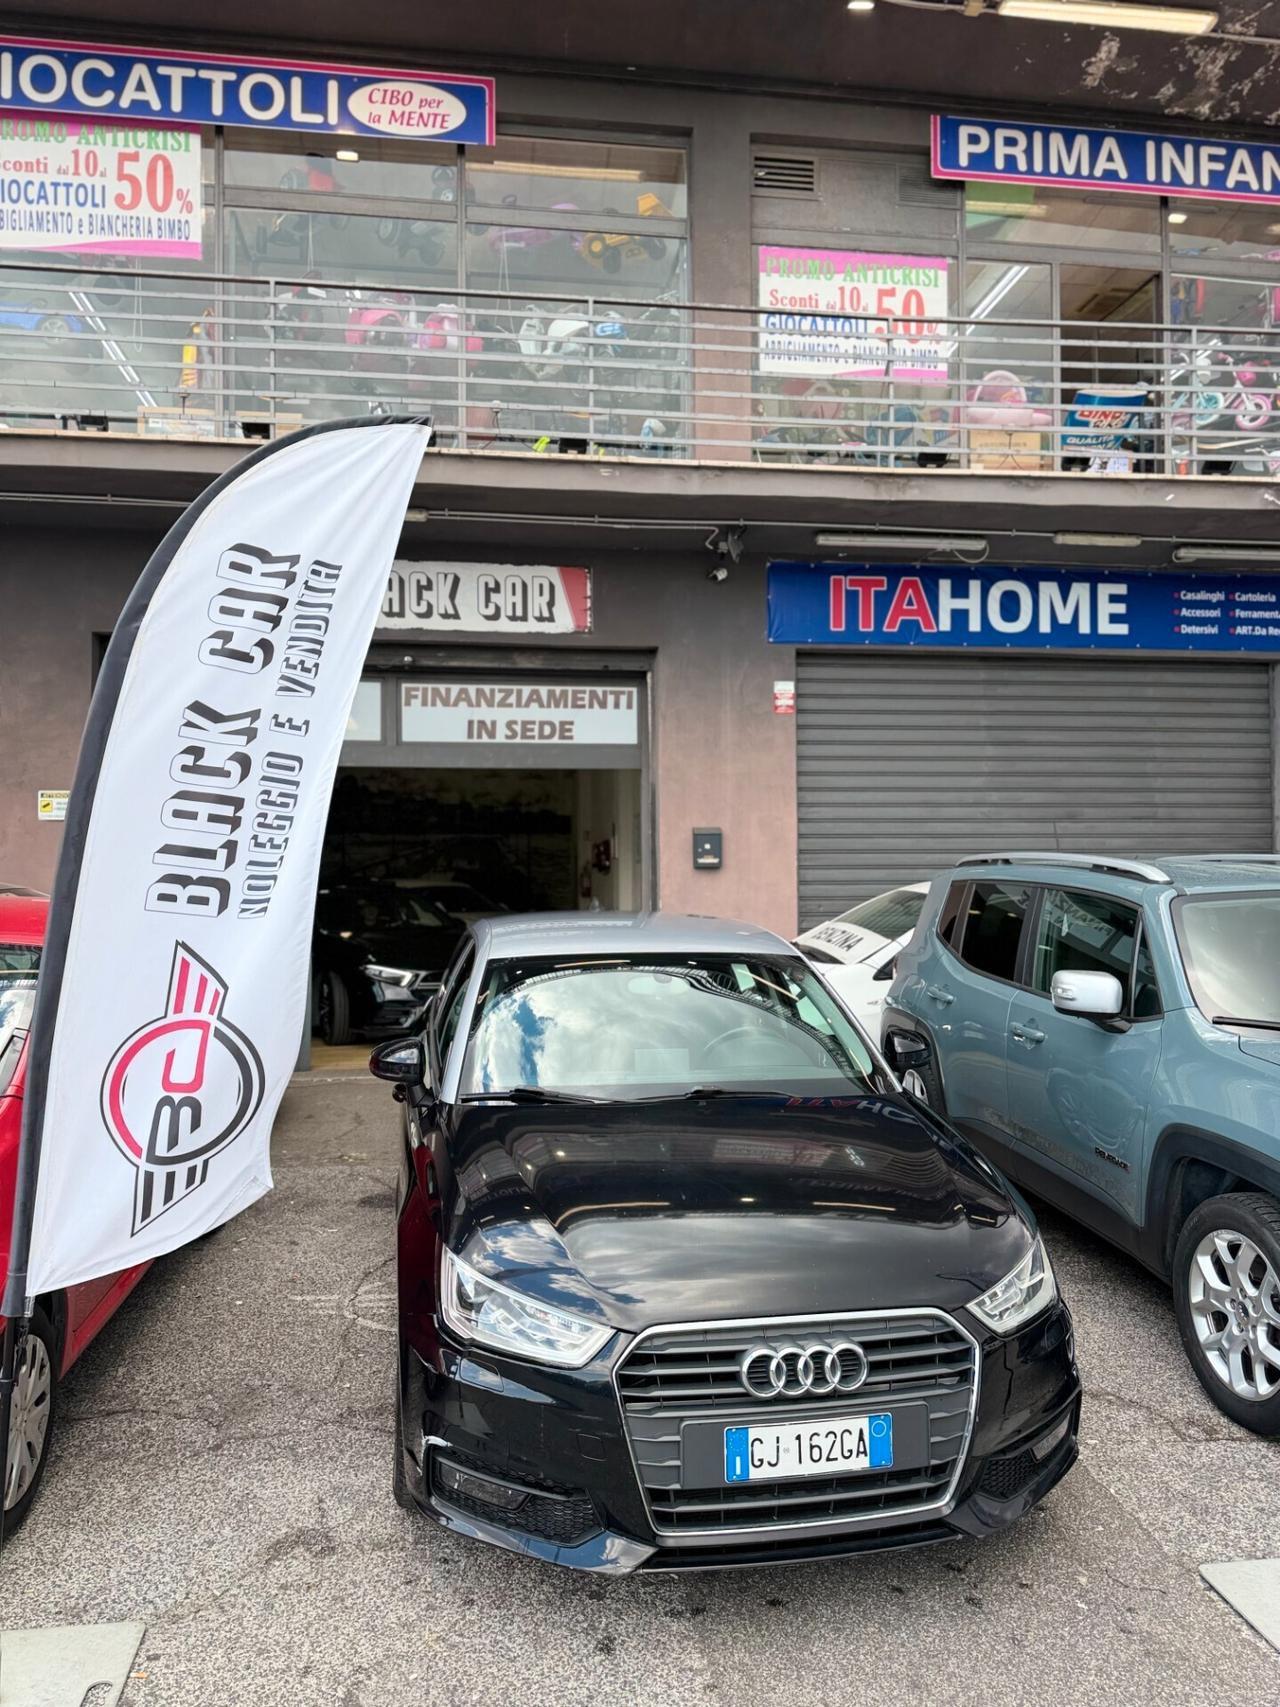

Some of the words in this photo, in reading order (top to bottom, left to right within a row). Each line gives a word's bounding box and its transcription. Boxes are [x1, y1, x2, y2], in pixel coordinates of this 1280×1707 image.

[1, 51, 339, 126] IOCATTOLI
[367, 88, 414, 107] CIBO
[418, 96, 444, 109] per
[368, 111, 381, 124] la
[388, 109, 451, 129] MENTE
[76, 124, 191, 152] ANTICRISI
[957, 124, 1128, 180] PRIMA
[0, 156, 49, 174] conti
[71, 149, 99, 177] 10
[0, 178, 106, 208] IOCATTOLI
[88, 213, 153, 238] BIANCHERIA
[157, 218, 191, 240] BIMBO
[766, 256, 835, 281] PROMO
[842, 264, 940, 288] ANTICRISI
[769, 289, 819, 309] Sconti
[838, 286, 862, 313] 10
[197, 542, 302, 675] CAR
[476, 573, 556, 623] CAR
[828, 575, 1129, 635] ITAHOME
[1180, 590, 1225, 603] Casalinghi
[1235, 592, 1276, 603] Cartoleria
[1181, 607, 1221, 618] Accessori
[275, 559, 343, 698] VENDITA
[1181, 624, 1219, 635] Detersivi
[403, 686, 634, 711] FINANZIAMENTI
[269, 713, 310, 738] E
[466, 719, 497, 740] IN
[504, 720, 575, 741] SEDE
[143, 699, 262, 918] BLACK
[236, 751, 304, 920] NOLEGGIO
[750, 1436, 780, 1468] GJ
[795, 1428, 868, 1464] 162GA
